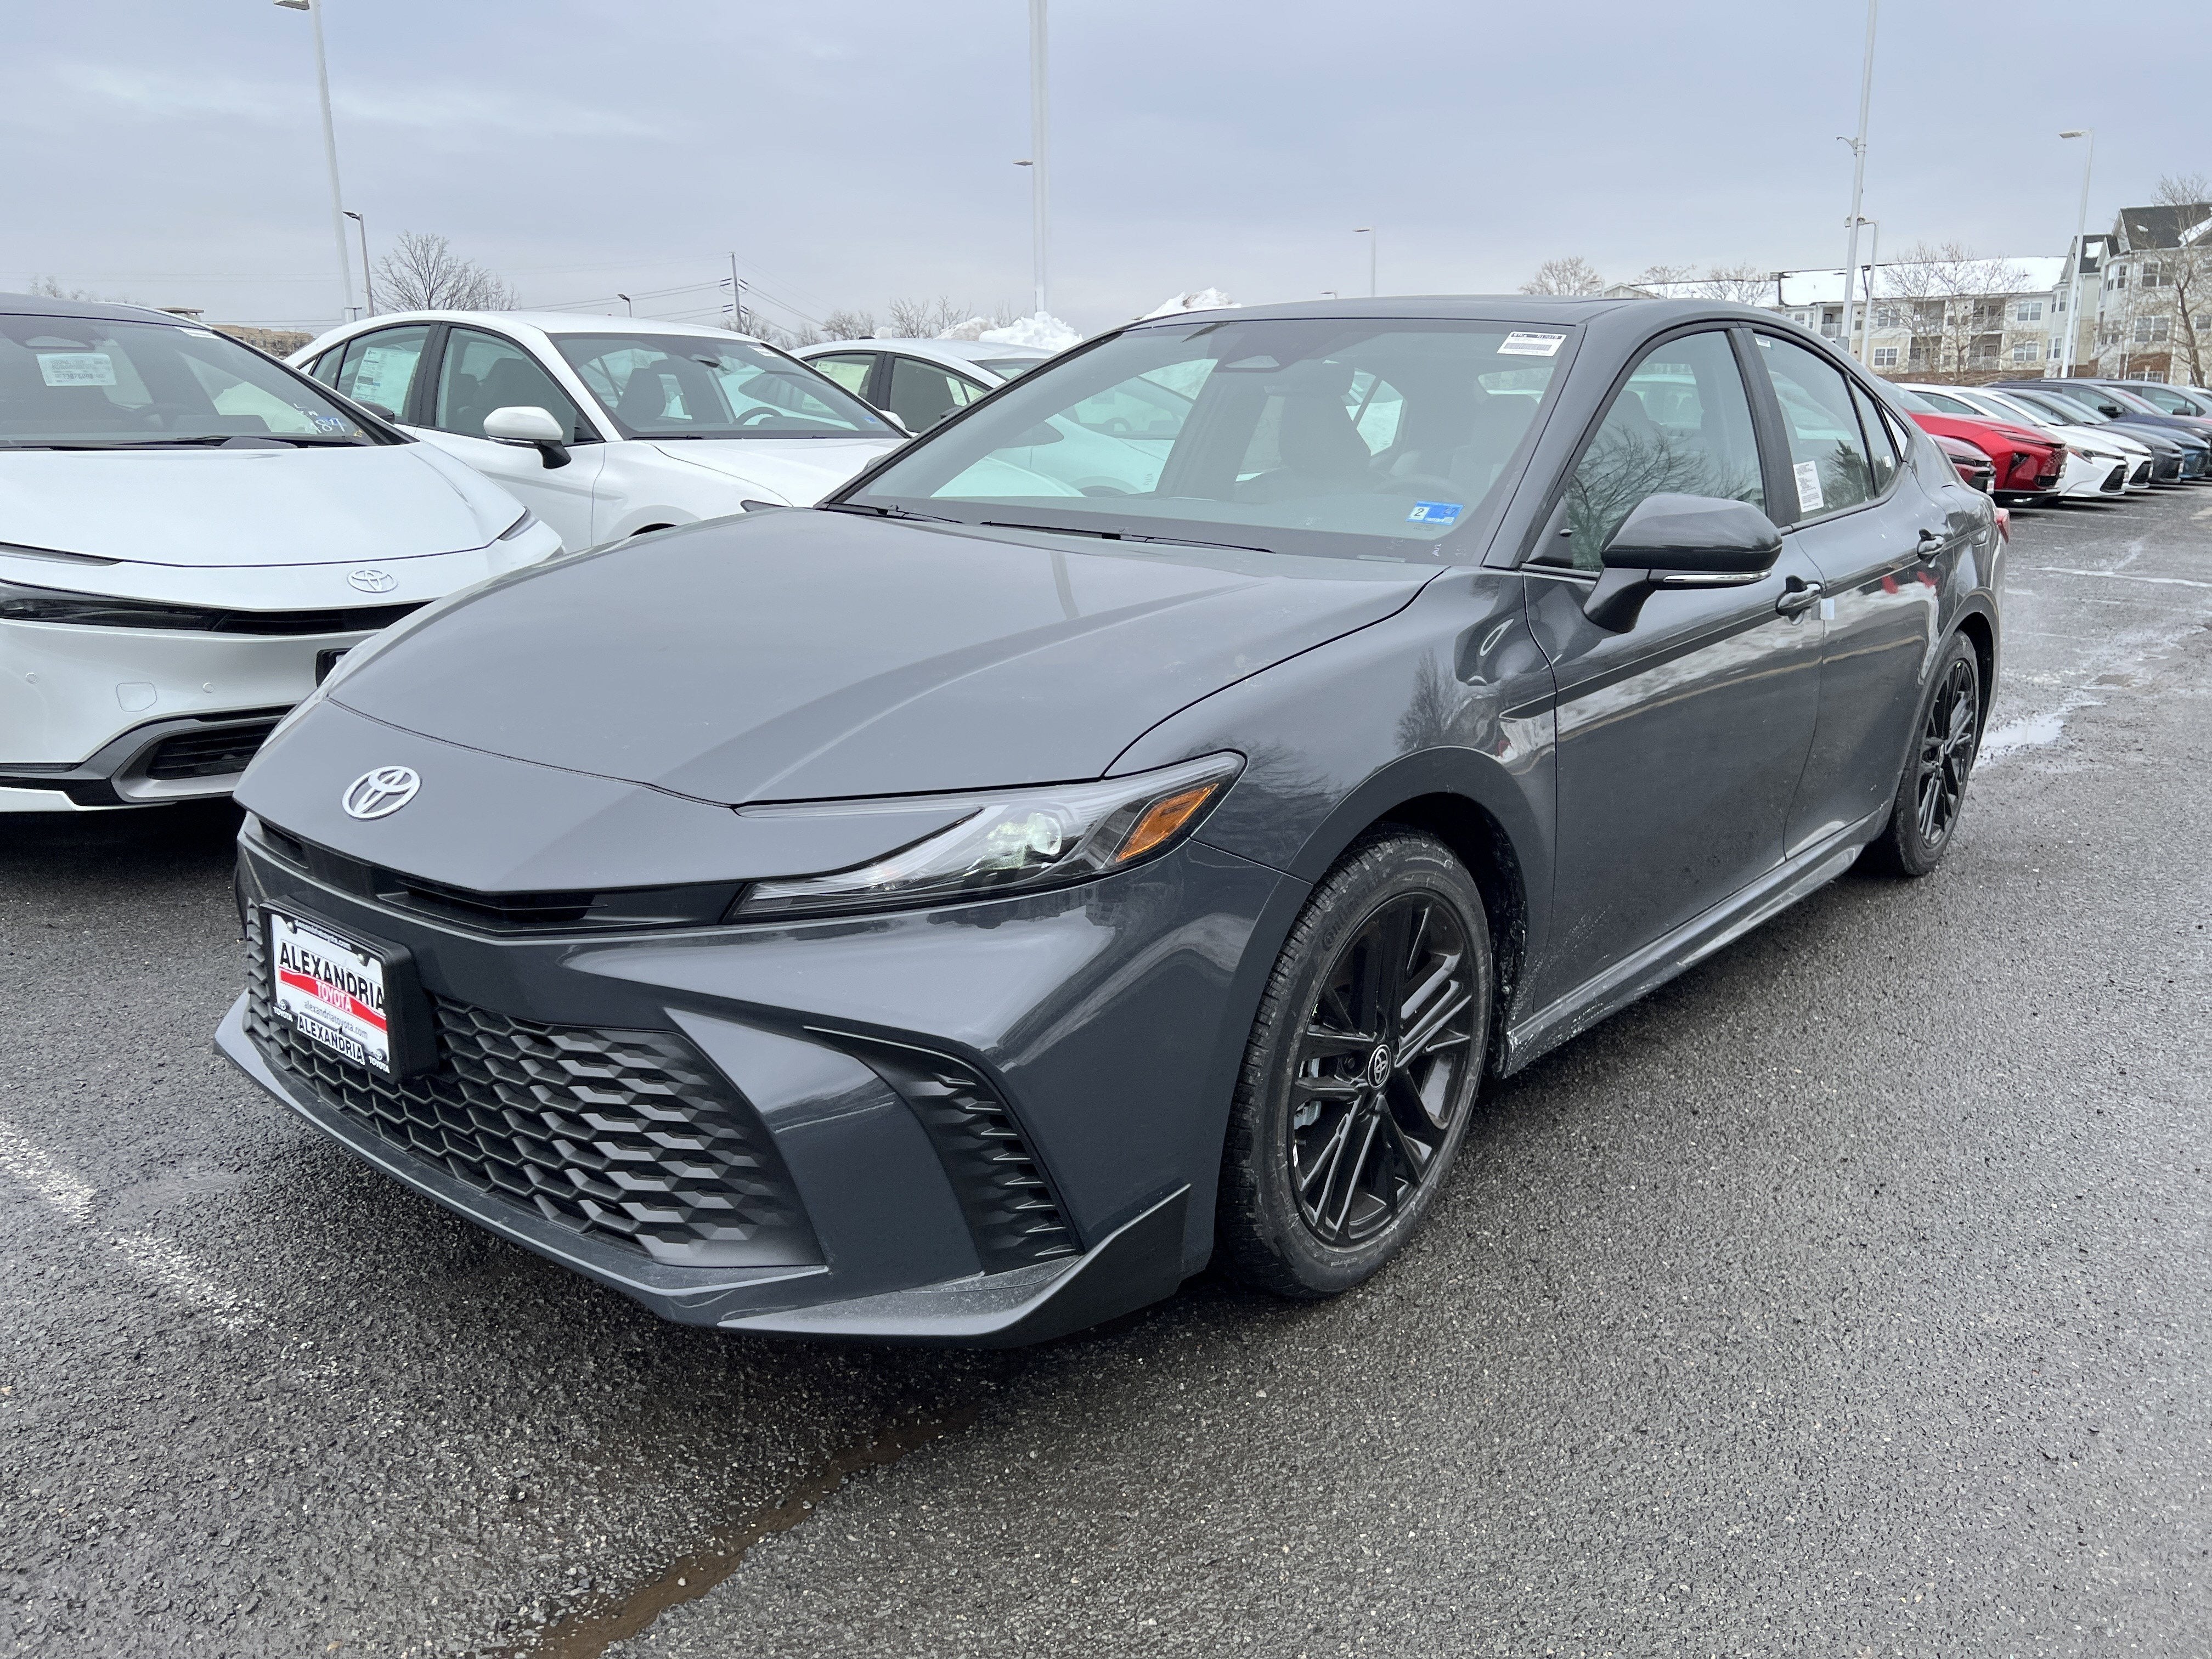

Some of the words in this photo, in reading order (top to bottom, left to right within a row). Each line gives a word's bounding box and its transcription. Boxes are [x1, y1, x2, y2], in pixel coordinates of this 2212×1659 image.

[1414, 507, 1425, 517] 2
[280, 941, 384, 1009] ALEXANDRIA
[316, 981, 353, 1013] TOYOTA
[273, 1006, 294, 1022] TOYOTA
[299, 1019, 364, 1063] ALEXANDRIA
[368, 1055, 391, 1074] TOYOTA
